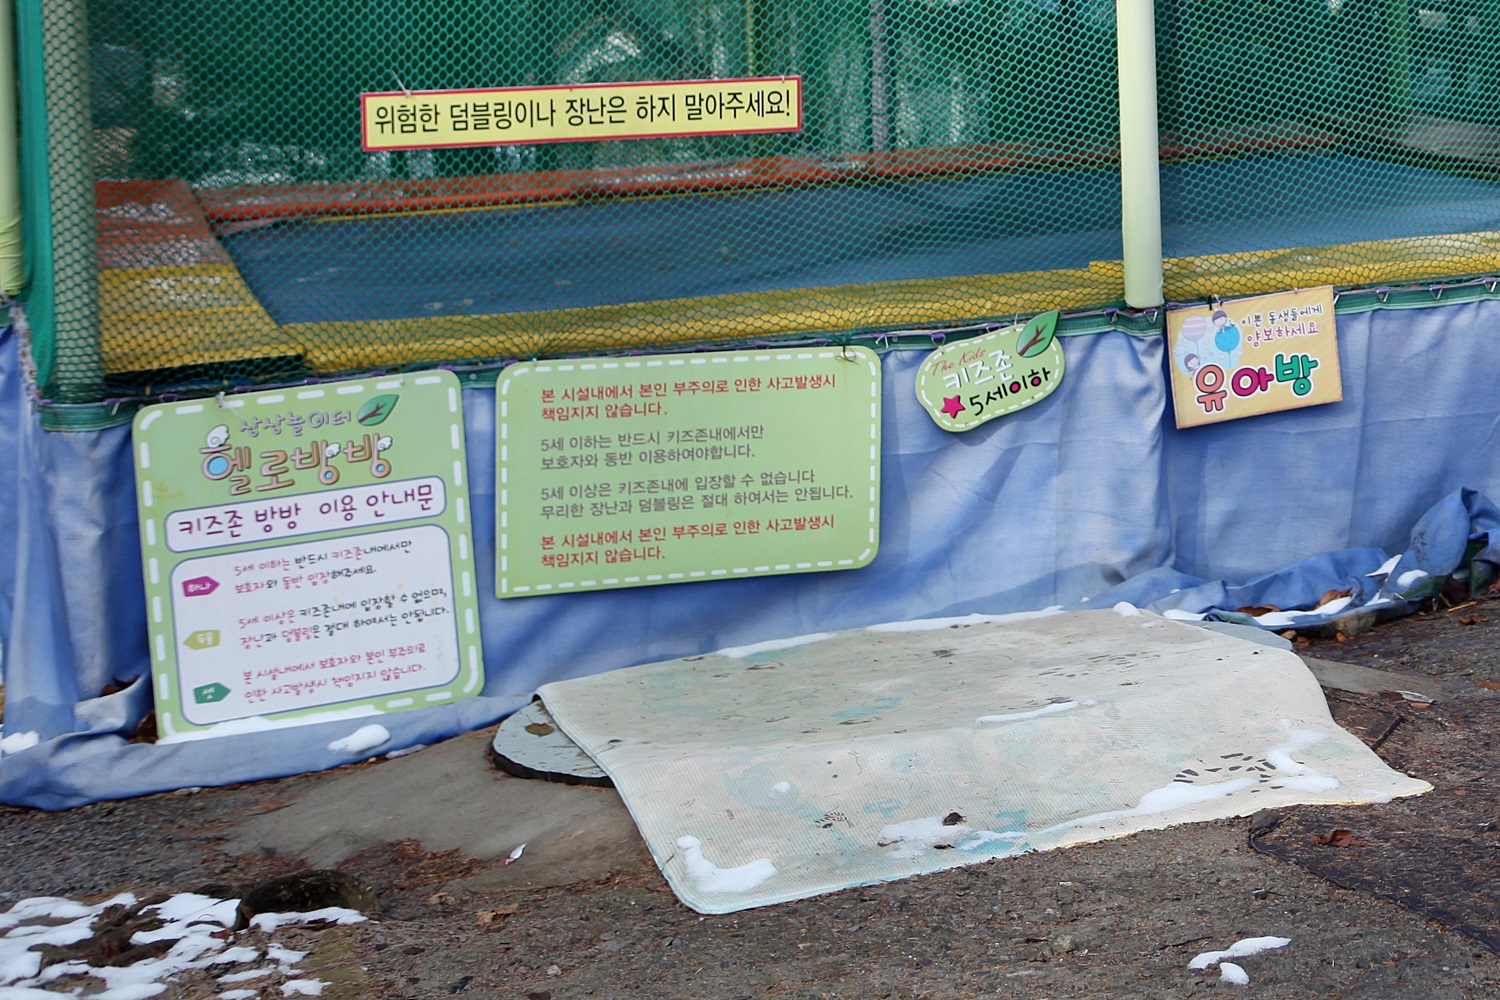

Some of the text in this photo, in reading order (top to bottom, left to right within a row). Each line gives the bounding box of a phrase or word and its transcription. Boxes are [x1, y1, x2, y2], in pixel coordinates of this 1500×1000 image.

[375, 89, 790, 133] 위험한 덤블링이나 장난은 하지 말아주세요!
[1242, 304, 1323, 327] 이쁜 동생들에게
[1247, 321, 1319, 347] 양보하세요
[943, 349, 1014, 388] 키즈존
[959, 347, 986, 365] Kids
[541, 374, 836, 403] 본 시설내에서 본인 부주의로 인한 사고발생시
[969, 367, 1051, 416] 5세이하
[1195, 354, 1319, 413] 유아방
[240, 411, 352, 437] 상상놀이터
[541, 402, 668, 421] 책임지지 않습니다.
[541, 425, 764, 452] 5세 이하는 반드시 키즈존내에서만
[200, 428, 393, 496] 헬로방방
[541, 445, 755, 471] 보호자와 동반 이용하여야합니다.
[541, 470, 815, 501] 5세 이상은 키즈존내에 입장할 수 없습니다
[178, 484, 433, 538] 키즈존 방방 이용 안내문
[541, 503, 584, 520] 무리한
[590, 500, 632, 516] 장난과
[701, 492, 728, 507] 절대
[734, 487, 789, 505] 하여서는
[795, 485, 853, 502] 안됩니다.
[541, 514, 835, 550] 본 시설내에서 본인 부주의로 인한 사고발생시
[541, 547, 665, 568] 책임지지 않습니다.
